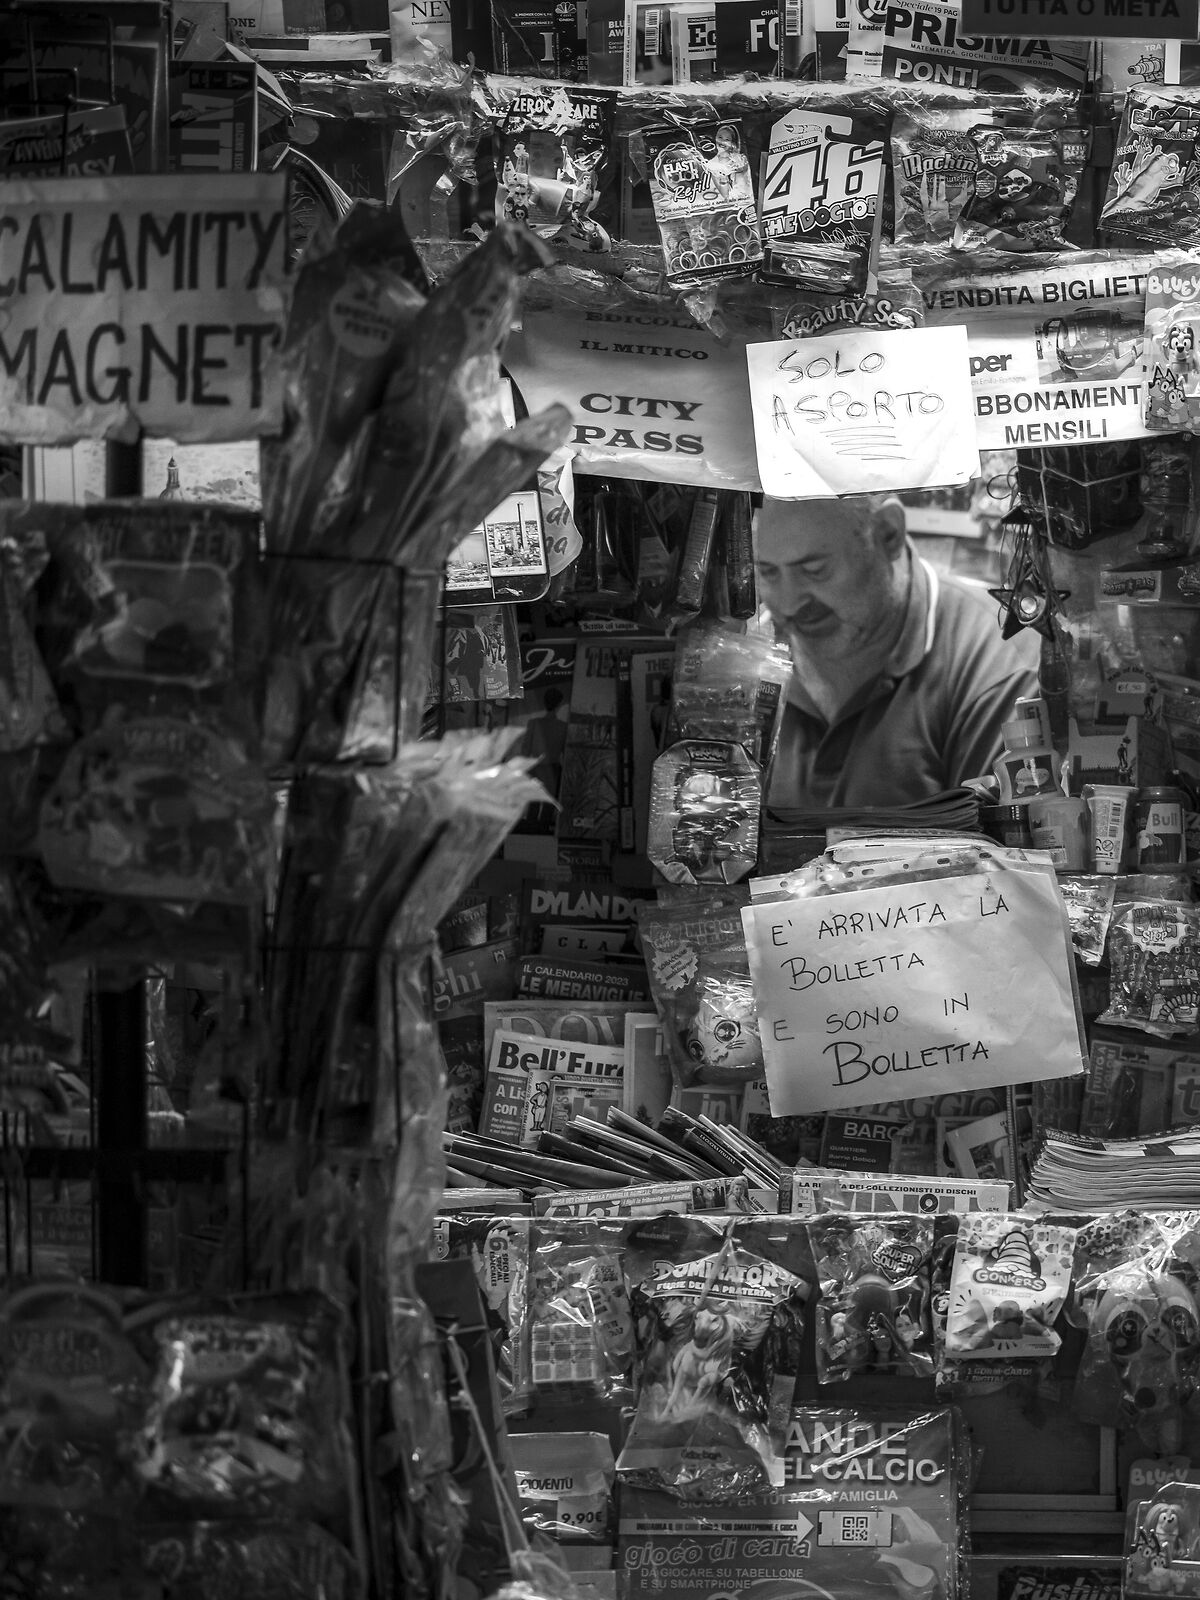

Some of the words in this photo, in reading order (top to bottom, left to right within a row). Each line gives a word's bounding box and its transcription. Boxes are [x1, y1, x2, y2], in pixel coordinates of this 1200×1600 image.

[858, 24, 882, 33] Leader
[893, 57, 979, 90] PONTI
[1027, 59, 1054, 68] MONDO
[772, 141, 799, 153] VALENTINO
[800, 137, 815, 146] ROSSI
[761, 122, 883, 218] 46
[673, 172, 712, 203] Refill
[760, 215, 797, 241] THE
[798, 195, 880, 233] DOCTOR
[0, 209, 285, 297] CALAMITY
[923, 285, 1034, 311] VENDITA
[585, 311, 706, 331] EDICOLA
[782, 298, 867, 340] Beauty
[0, 322, 281, 408] MAGNET
[579, 340, 608, 352] IL
[612, 343, 709, 361] MITICO
[777, 349, 886, 384] SOLO
[579, 393, 703, 422] CITY
[771, 389, 945, 436] ASPORTO
[975, 384, 1142, 417] BBONAMENT
[571, 424, 705, 455] PASS
[1005, 418, 1108, 446] MENSILI
[1152, 812, 1178, 827] Bull
[530, 888, 608, 919] DYLAN
[772, 919, 794, 946] E'
[818, 902, 947, 940] ARRIVATA
[979, 894, 1010, 917] LA
[522, 964, 531, 973] IL
[535, 966, 603, 983] CALENDARIO
[605, 975, 629, 986] 2023
[781, 952, 925, 991] BOLLETTA
[520, 975, 541, 993] LE
[545, 978, 645, 1001] MERAVIGLIE
[773, 1019, 795, 1041] E
[825, 1005, 899, 1034] SONO
[943, 993, 969, 1016] IN
[823, 1041, 989, 1087] BOLLETTA
[866, 1184, 933, 1194] COLLEZIONISTI
[883, 1246, 915, 1263] SUPER
[976, 1269, 1046, 1290] GONKERS
[821, 1457, 939, 1482] CALCIO
[561, 1510, 603, 1526] 9,90€
[625, 1541, 703, 1570] gioco
[708, 1537, 738, 1563] di
[742, 1537, 812, 1559] carta
[641, 1567, 656, 1578] DA
[660, 1567, 713, 1578] GIOCARE
[716, 1567, 732, 1578] SU
[736, 1567, 804, 1579] TABELLONE
[641, 1579, 648, 1589] E
[651, 1579, 667, 1589] SU
[670, 1579, 752, 1590] SMARTPHONE
